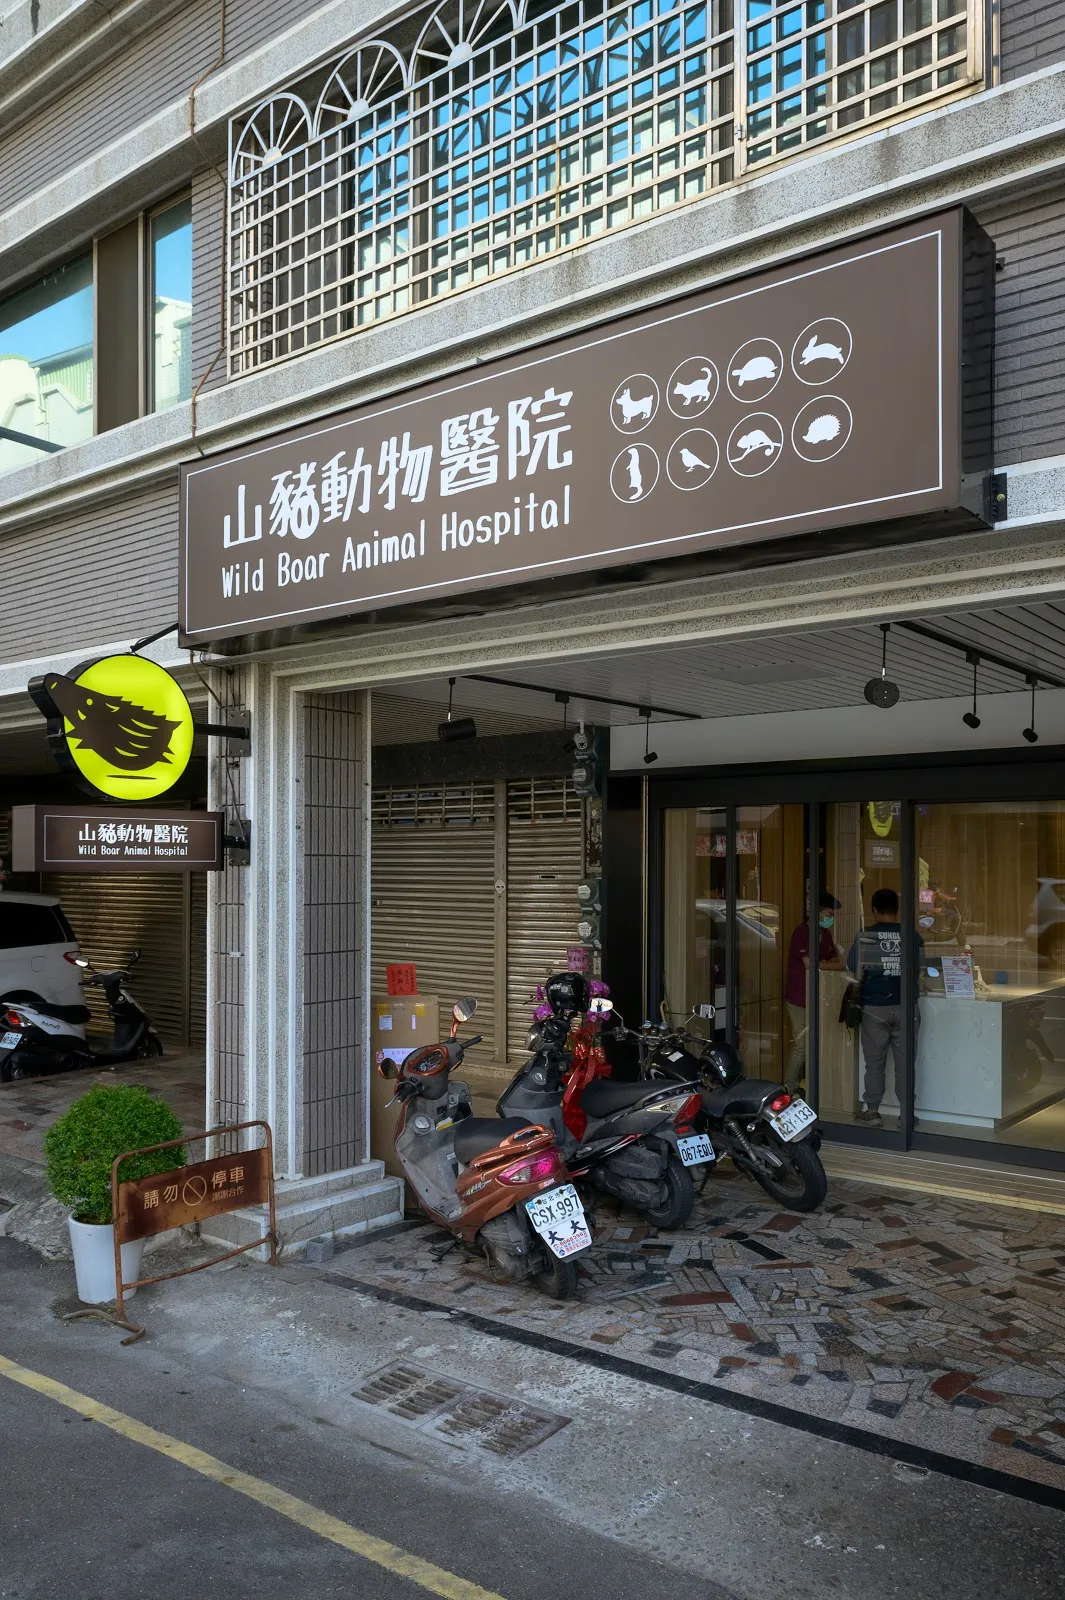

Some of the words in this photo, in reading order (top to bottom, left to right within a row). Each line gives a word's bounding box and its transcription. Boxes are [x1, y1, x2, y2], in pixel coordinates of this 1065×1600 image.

[223, 387, 574, 549] 山豬動物醫院
[221, 557, 265, 599] Wild
[277, 551, 330, 588] Boar
[341, 519, 426, 573] Animal
[440, 484, 572, 552] Hospital
[78, 823, 189, 844] 山豬動物醫院
[78, 844, 97, 855] Wild
[101, 845, 121, 855] Boar
[123, 845, 151, 856] Animal
[154, 846, 188, 856] Hospital
[144, 1184, 179, 1210] 請勿
[211, 1166, 245, 1190] 停車
[212, 1185, 245, 1202] 謝謝合作
